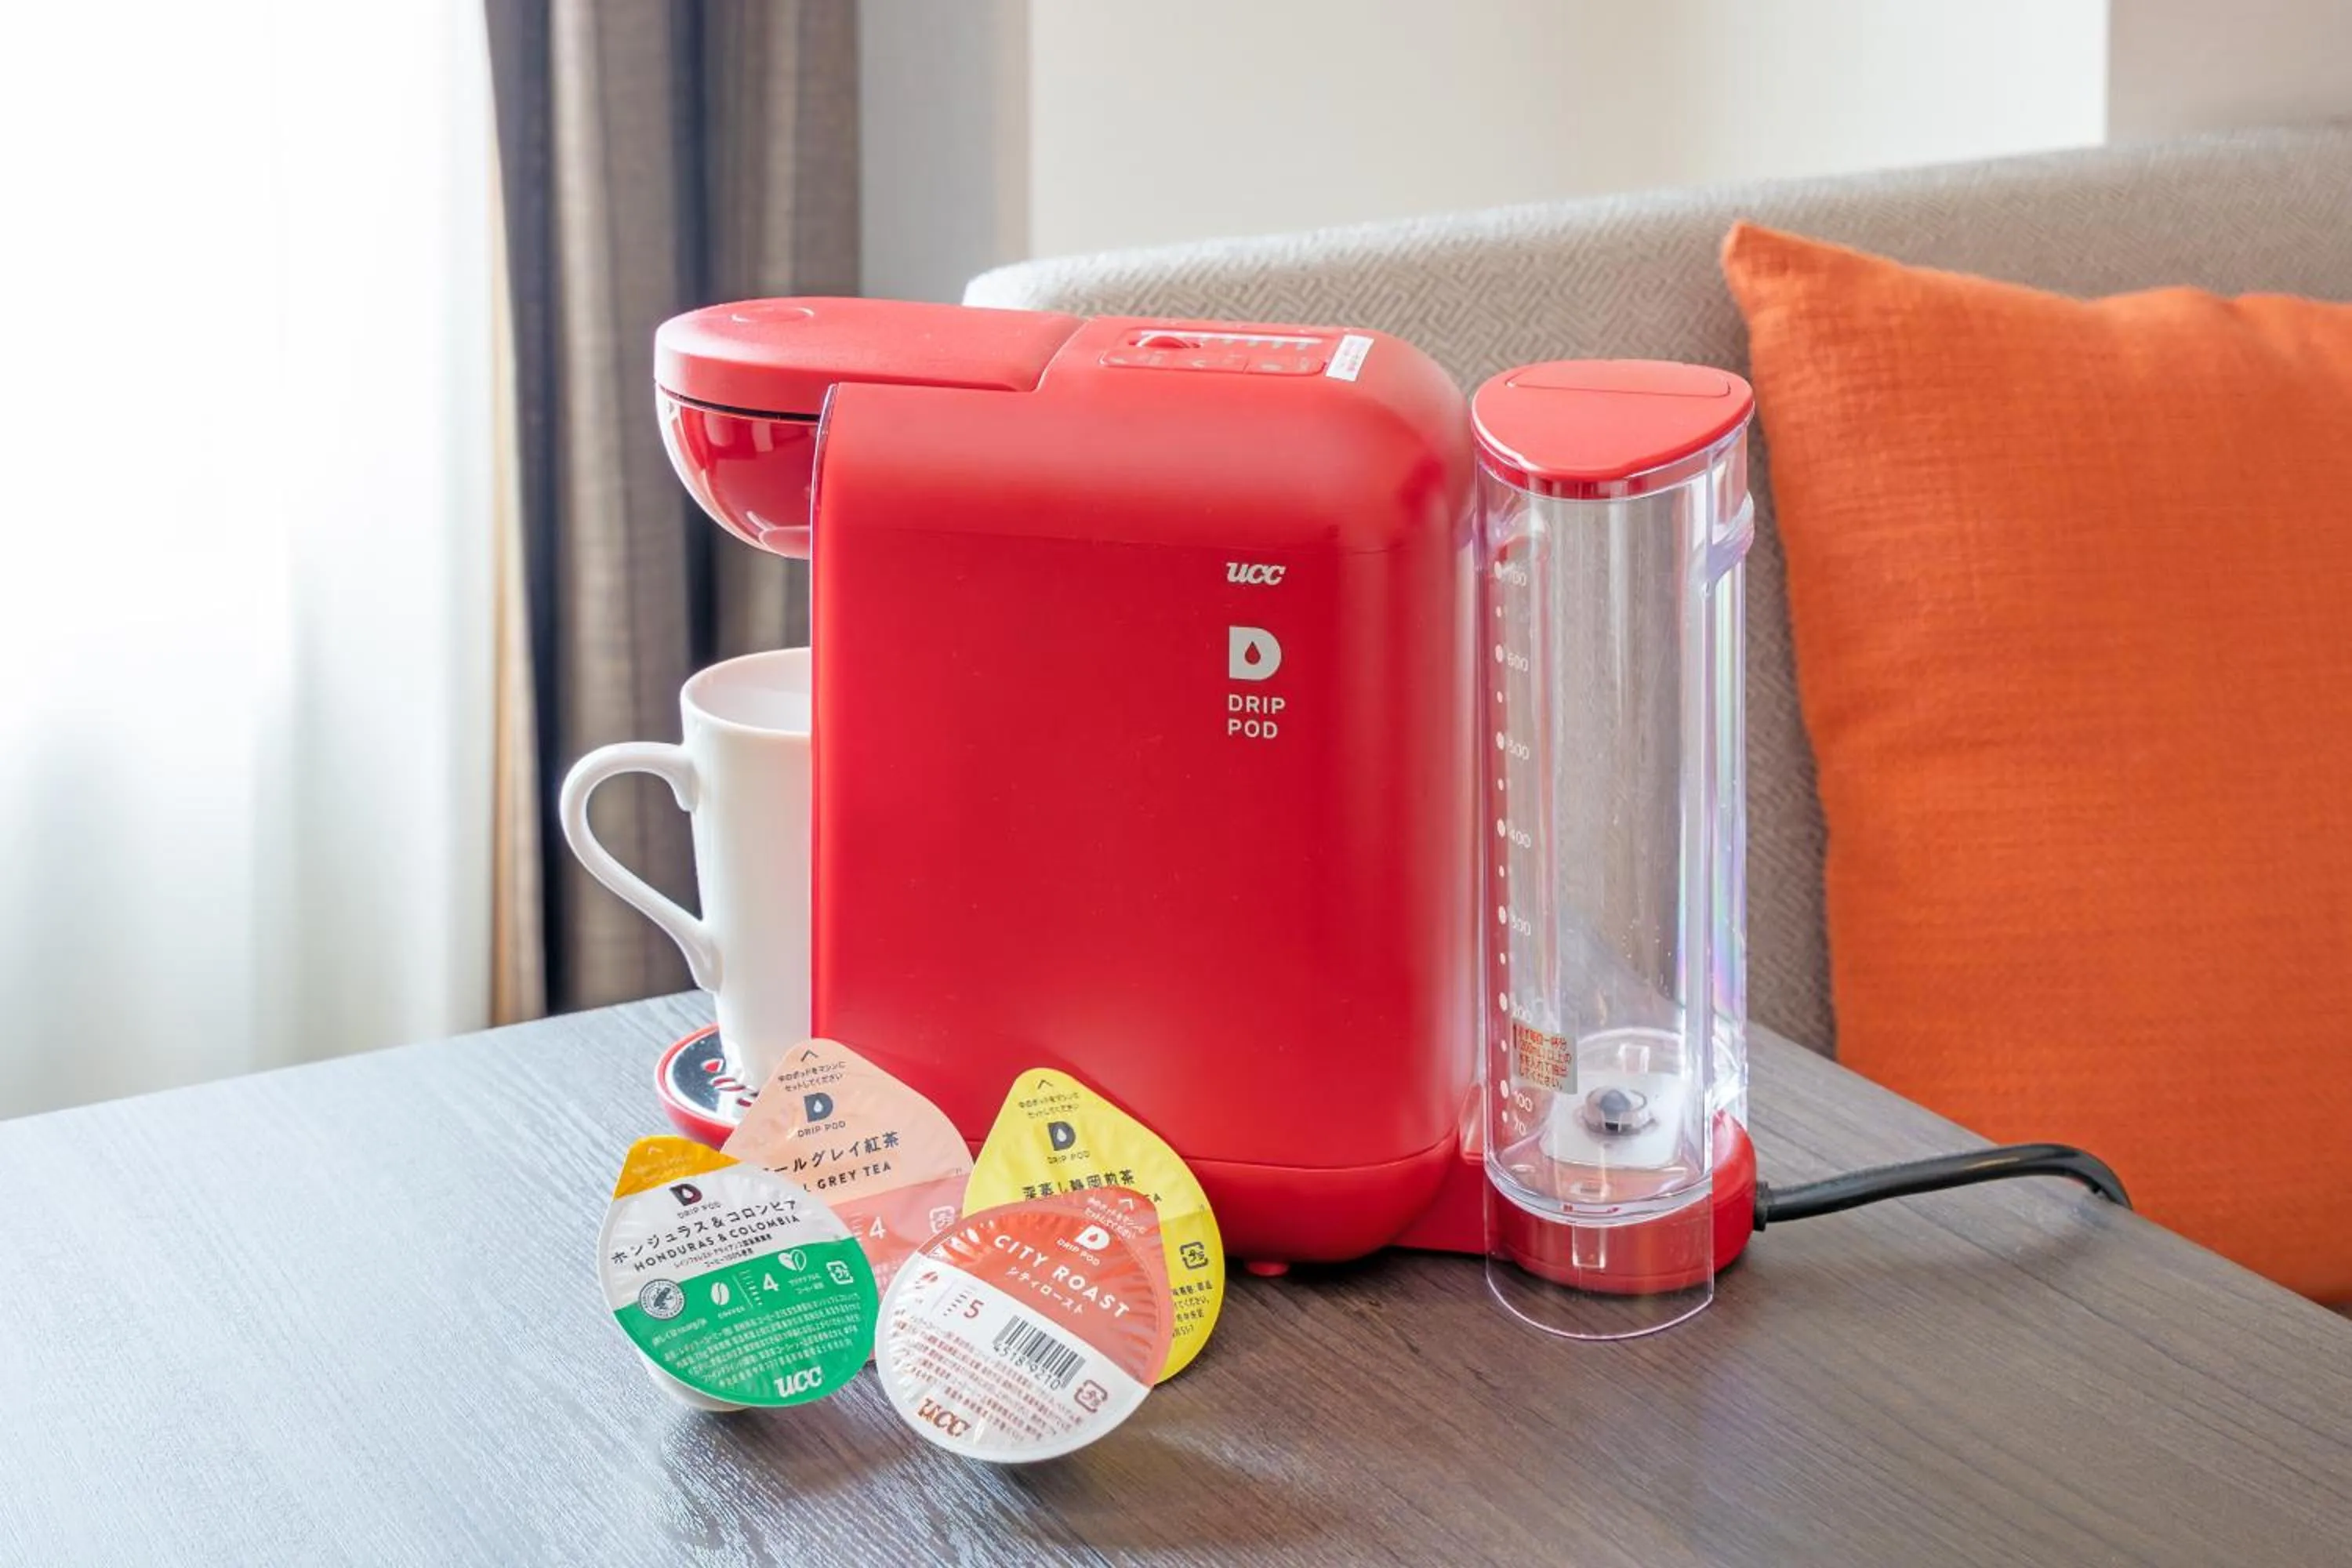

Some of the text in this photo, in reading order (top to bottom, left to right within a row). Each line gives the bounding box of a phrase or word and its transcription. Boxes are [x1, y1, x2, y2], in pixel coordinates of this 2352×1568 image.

[1228, 694, 1286, 714] DRIP
[1228, 718, 1278, 739] POD
[797, 1120, 846, 1138] DRIP POD
[763, 1131, 899, 1172] ールグレイ紅茶
[817, 1170, 856, 1190] GREY
[862, 1161, 891, 1177] TEA
[677, 1207, 699, 1219] DRIP
[869, 1216, 886, 1239] 4
[633, 1237, 714, 1272] HONDURAS
[730, 1214, 801, 1239] COLOMBIA
[1057, 1238, 1101, 1266] DRIP POD
[762, 1272, 779, 1292] 4
[994, 1235, 1130, 1318] CITY ROAST
[963, 1298, 985, 1319] 5
